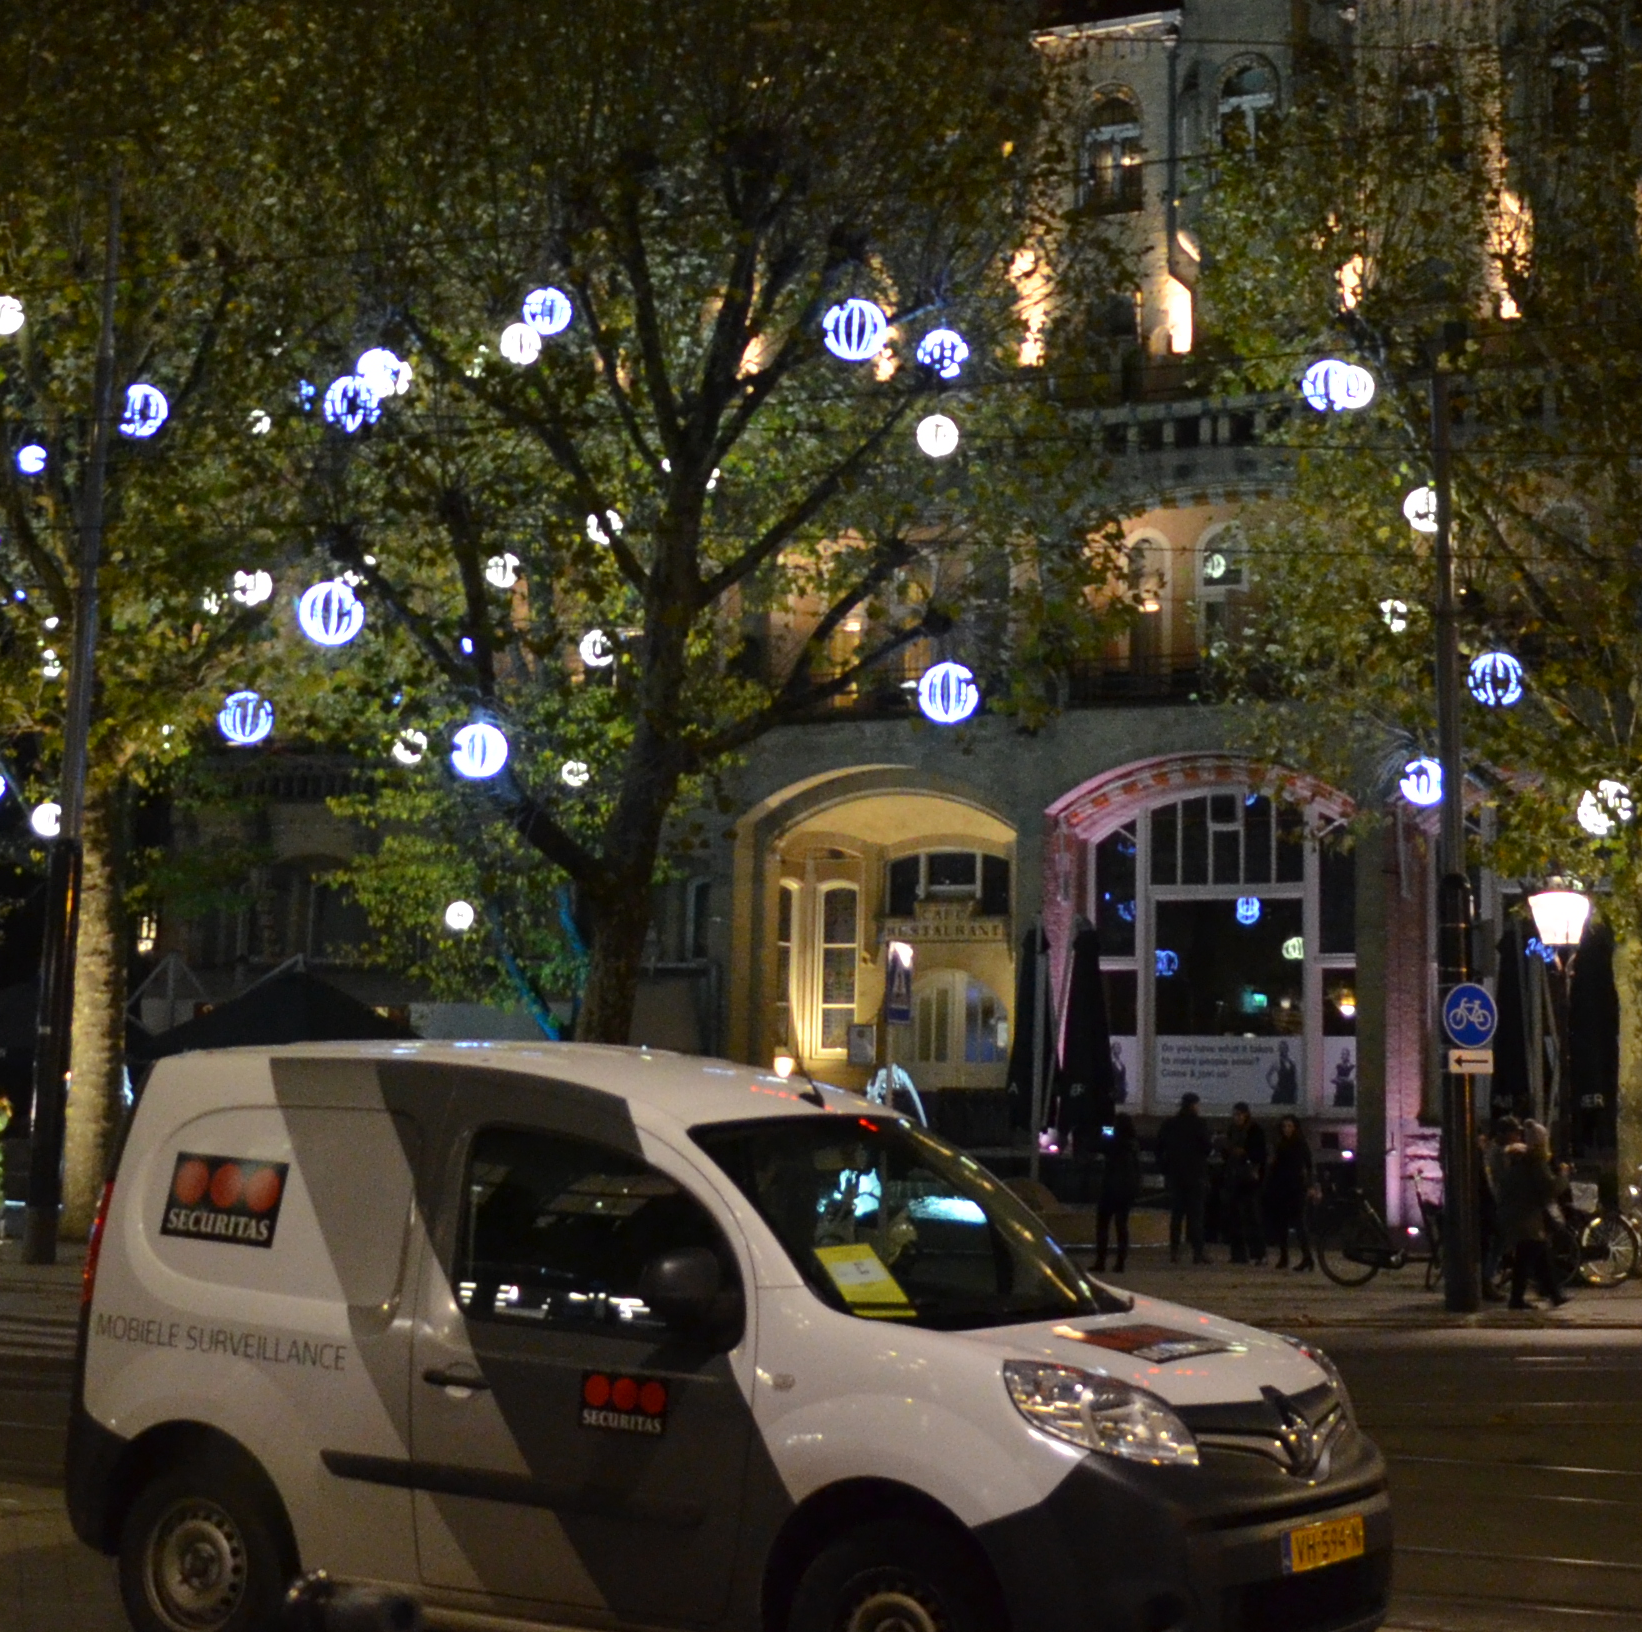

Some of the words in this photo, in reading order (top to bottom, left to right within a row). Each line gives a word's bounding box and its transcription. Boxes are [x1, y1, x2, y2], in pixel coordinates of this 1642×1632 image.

[165, 1207, 271, 1243] SECURITAS
[96, 1313, 180, 1348] MOBIELE
[185, 1324, 348, 1372] SURVEILLANCE
[581, 1408, 663, 1435] SECURITAS
